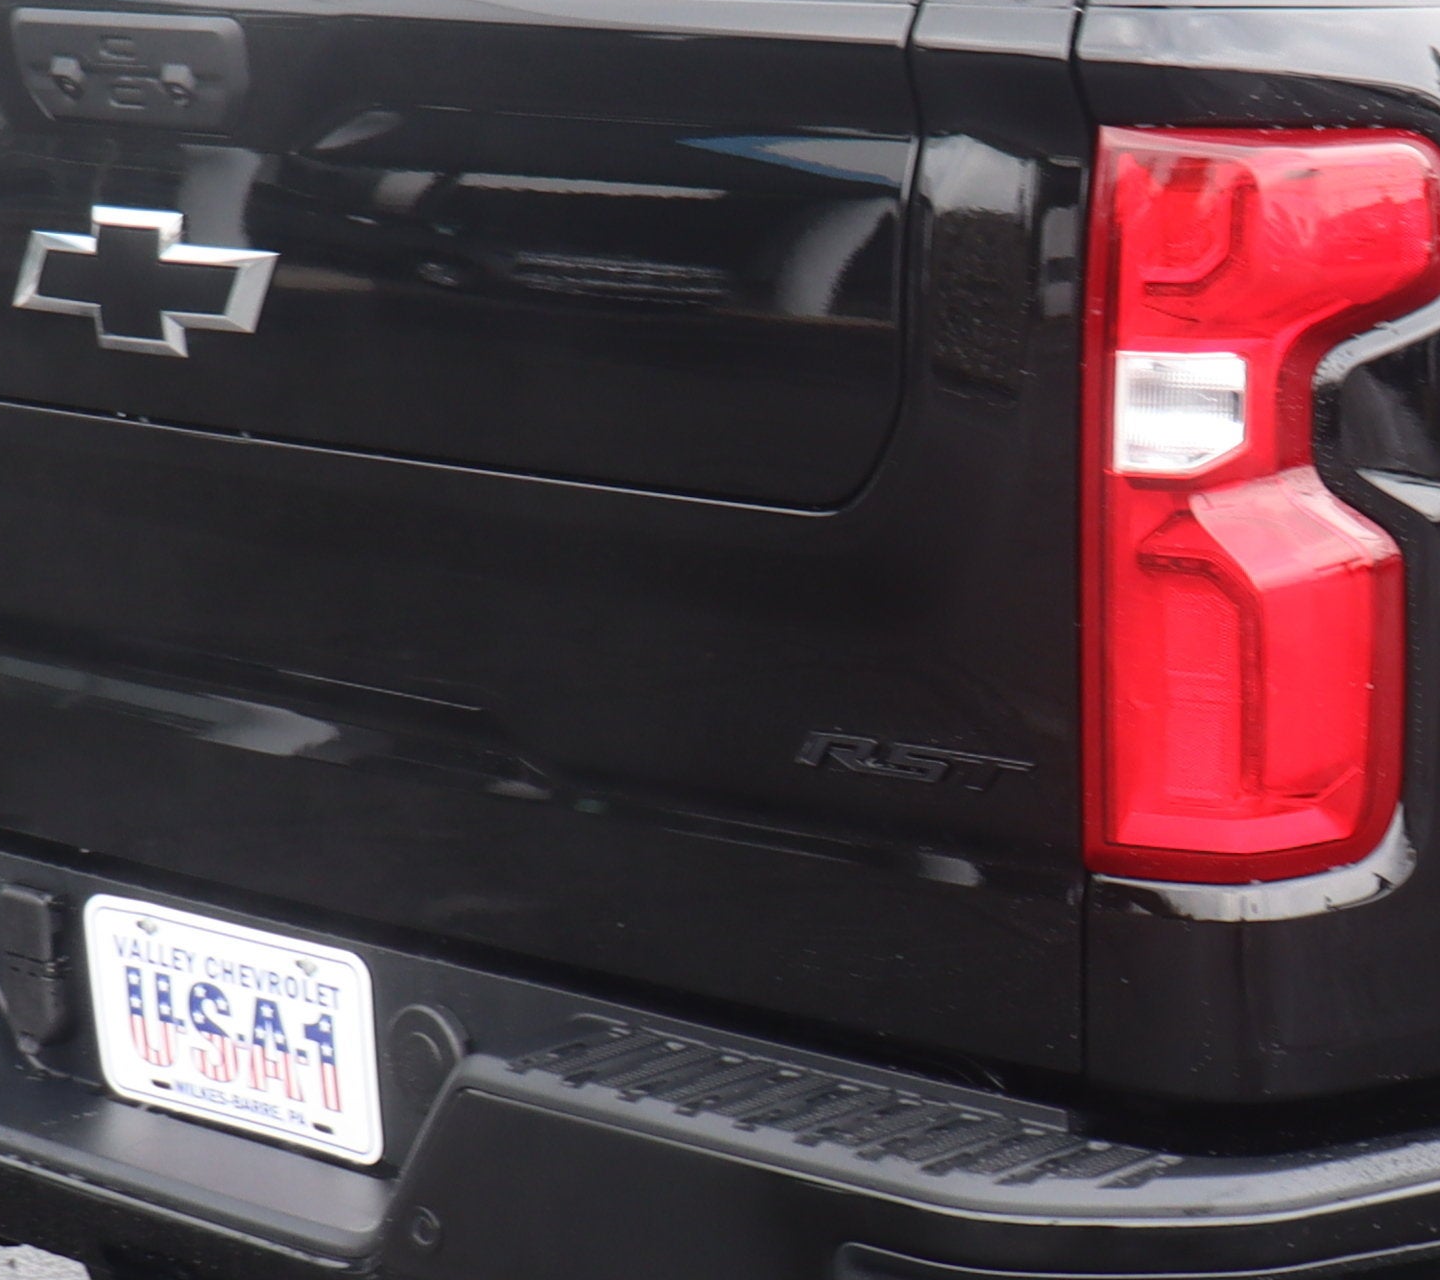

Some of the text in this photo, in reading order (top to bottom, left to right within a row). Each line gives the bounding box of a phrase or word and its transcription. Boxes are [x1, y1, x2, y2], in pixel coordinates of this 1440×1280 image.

[793, 728, 1038, 792] RST
[113, 933, 341, 1010] VALLEY CHEVROLET
